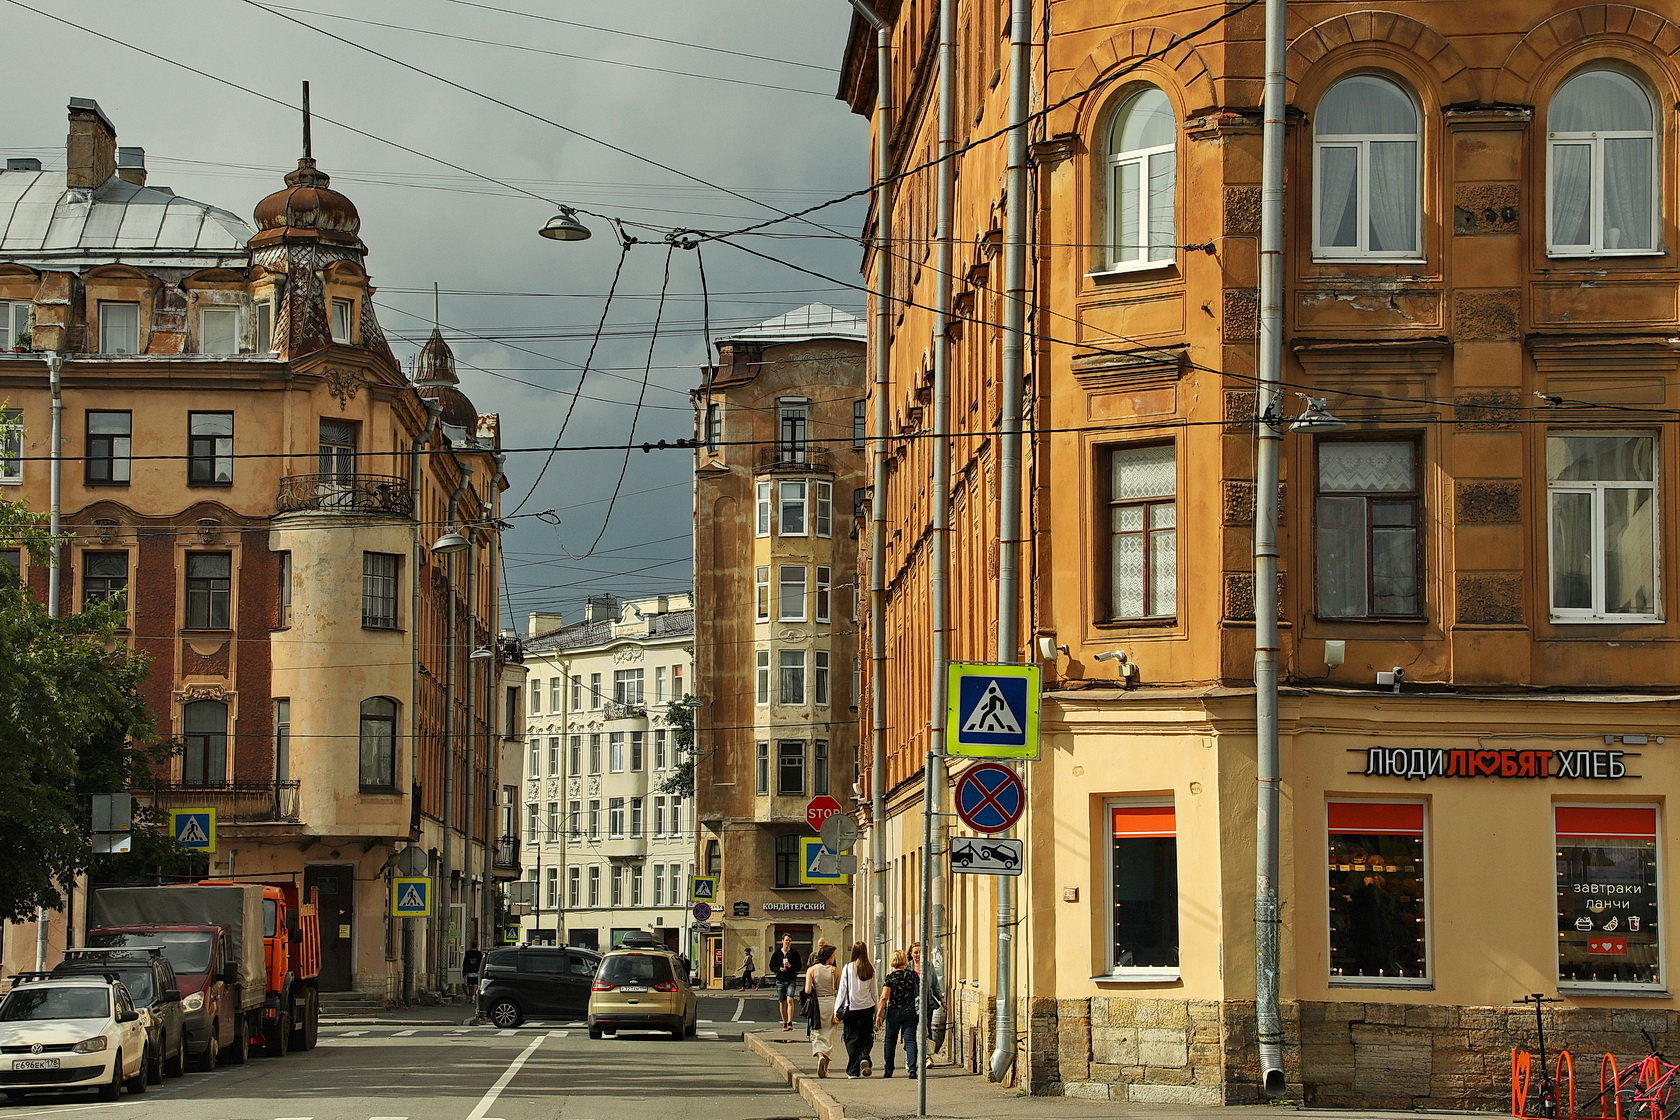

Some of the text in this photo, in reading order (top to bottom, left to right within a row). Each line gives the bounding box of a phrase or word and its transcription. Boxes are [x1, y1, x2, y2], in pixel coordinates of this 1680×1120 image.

[1366, 748, 1443, 779] ЛЮДИ
[1558, 751, 1625, 778] ХЛЕБ
[1573, 883, 1642, 896] завтраки
[763, 902, 825, 911] КОНДИТЕРСКИЙ
[1585, 899, 1630, 909] ланчи
